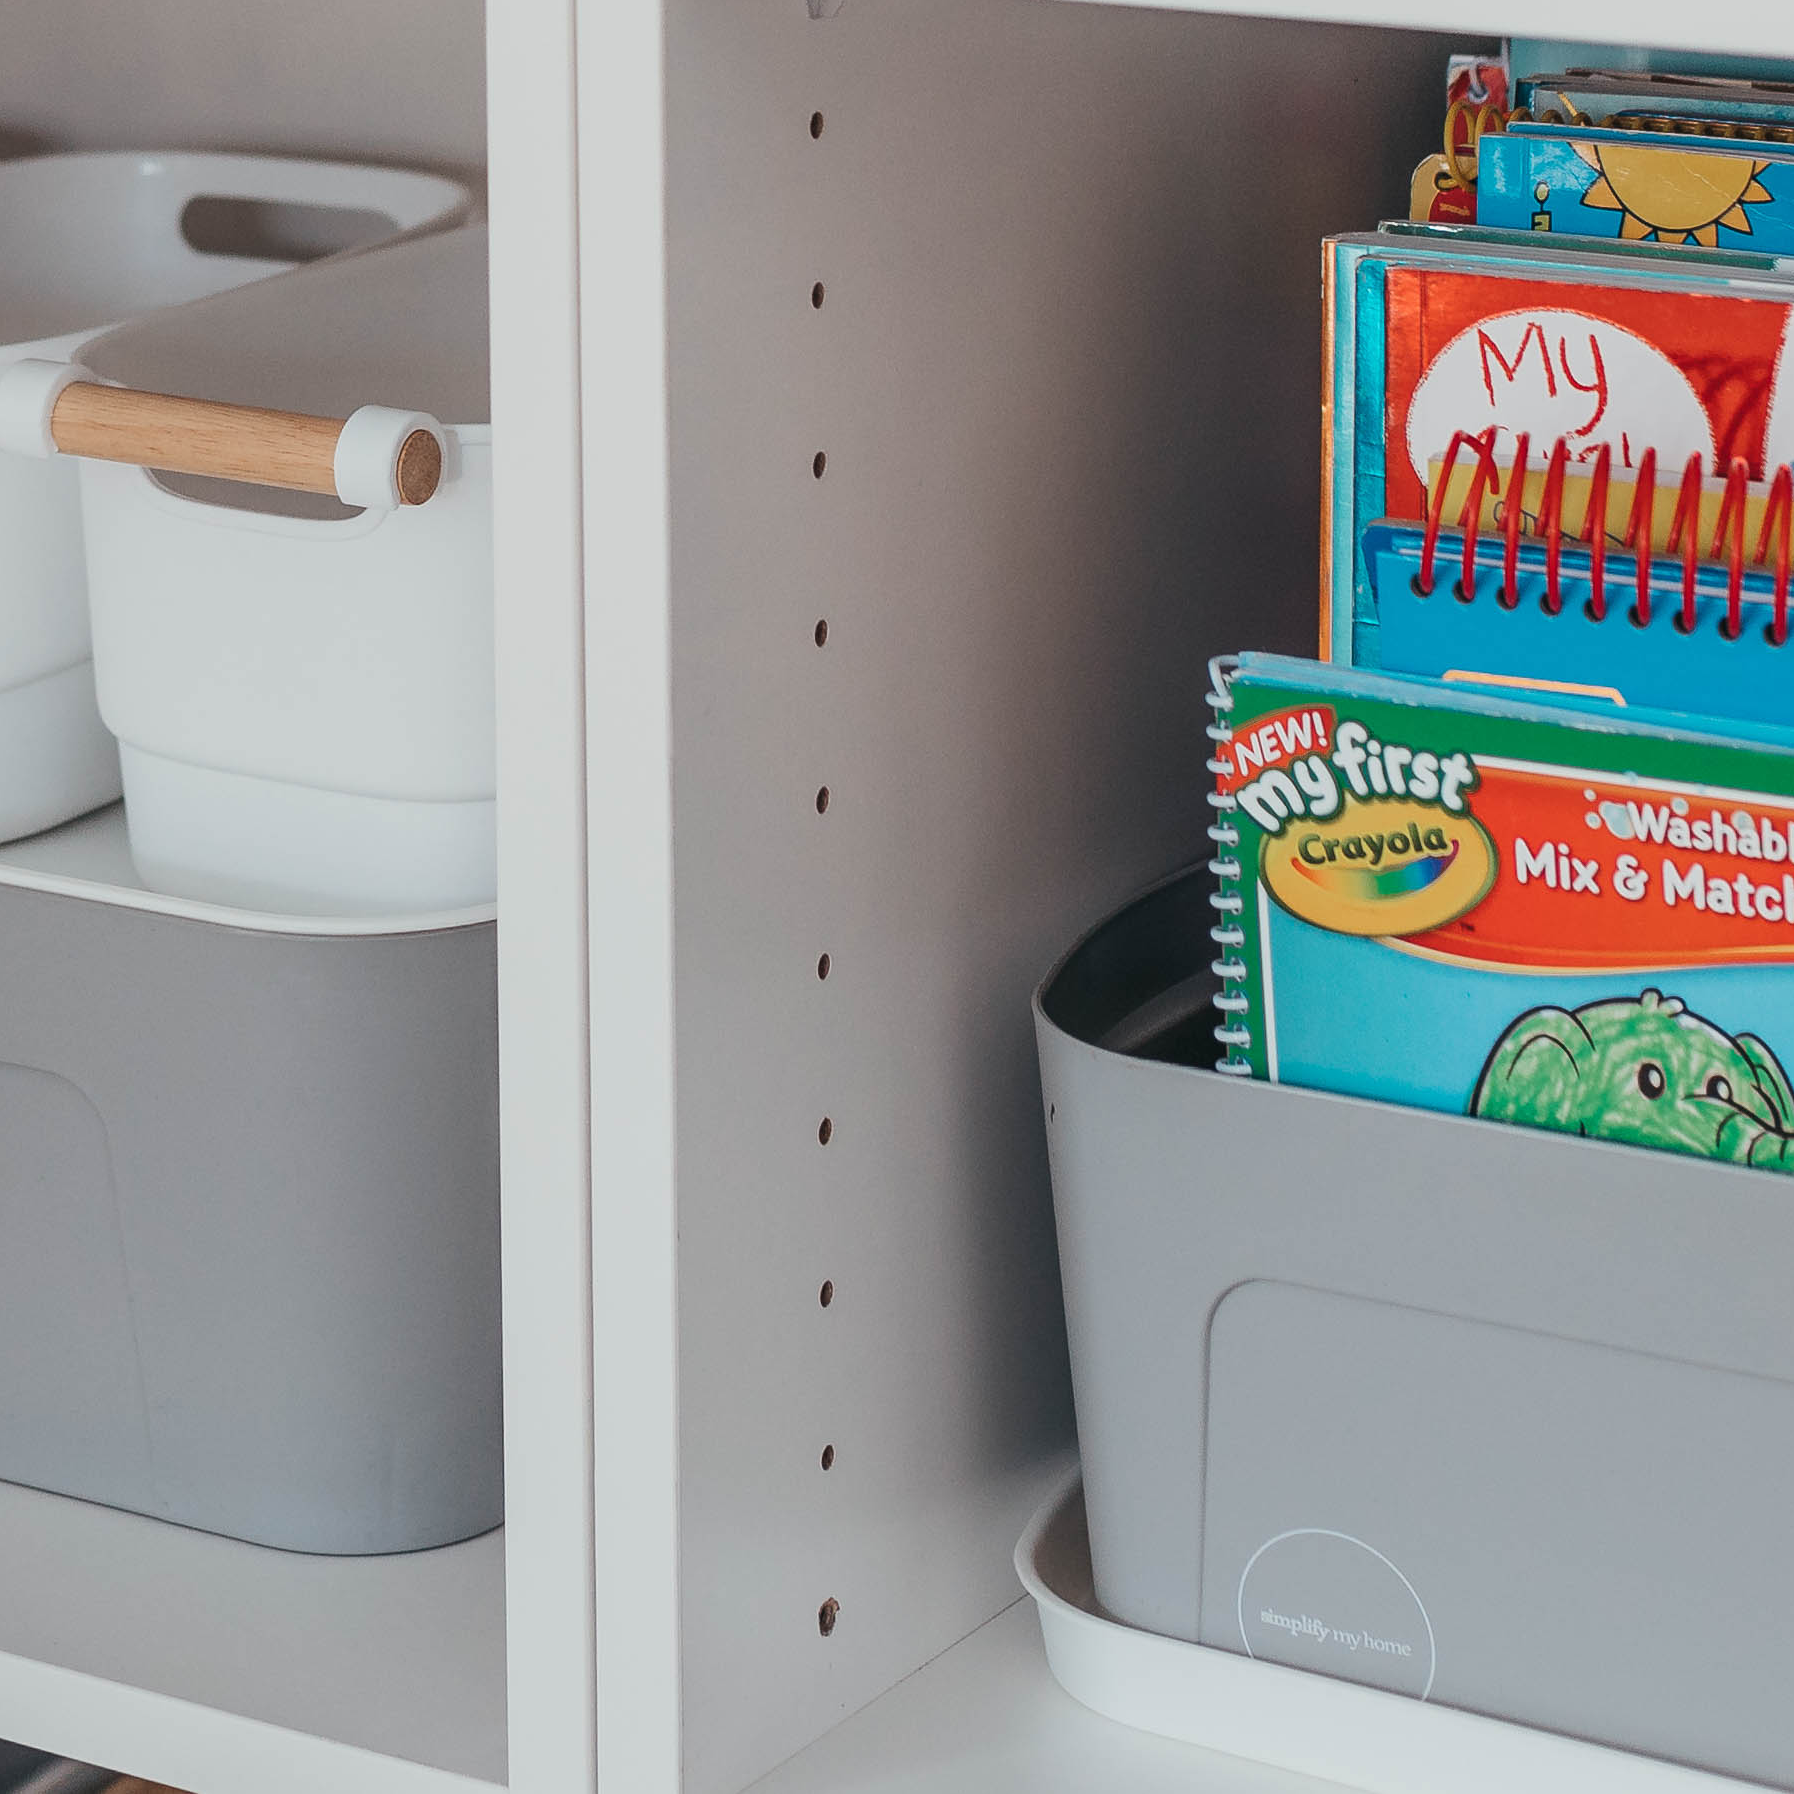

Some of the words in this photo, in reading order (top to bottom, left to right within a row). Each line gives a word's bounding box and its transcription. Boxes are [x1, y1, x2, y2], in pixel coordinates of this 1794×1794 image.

[1476, 321, 1609, 439] My
[1235, 711, 1328, 777] NEW!
[1236, 755, 1339, 832] my
[1332, 721, 1473, 811] first
[1298, 822, 1447, 865] Crayola
[1514, 837, 1601, 895] Mix
[1612, 853, 1648, 901] &
[1261, 1608, 1330, 1643] simplify
[1332, 1629, 1360, 1651] my
[1363, 1631, 1413, 1657] home
